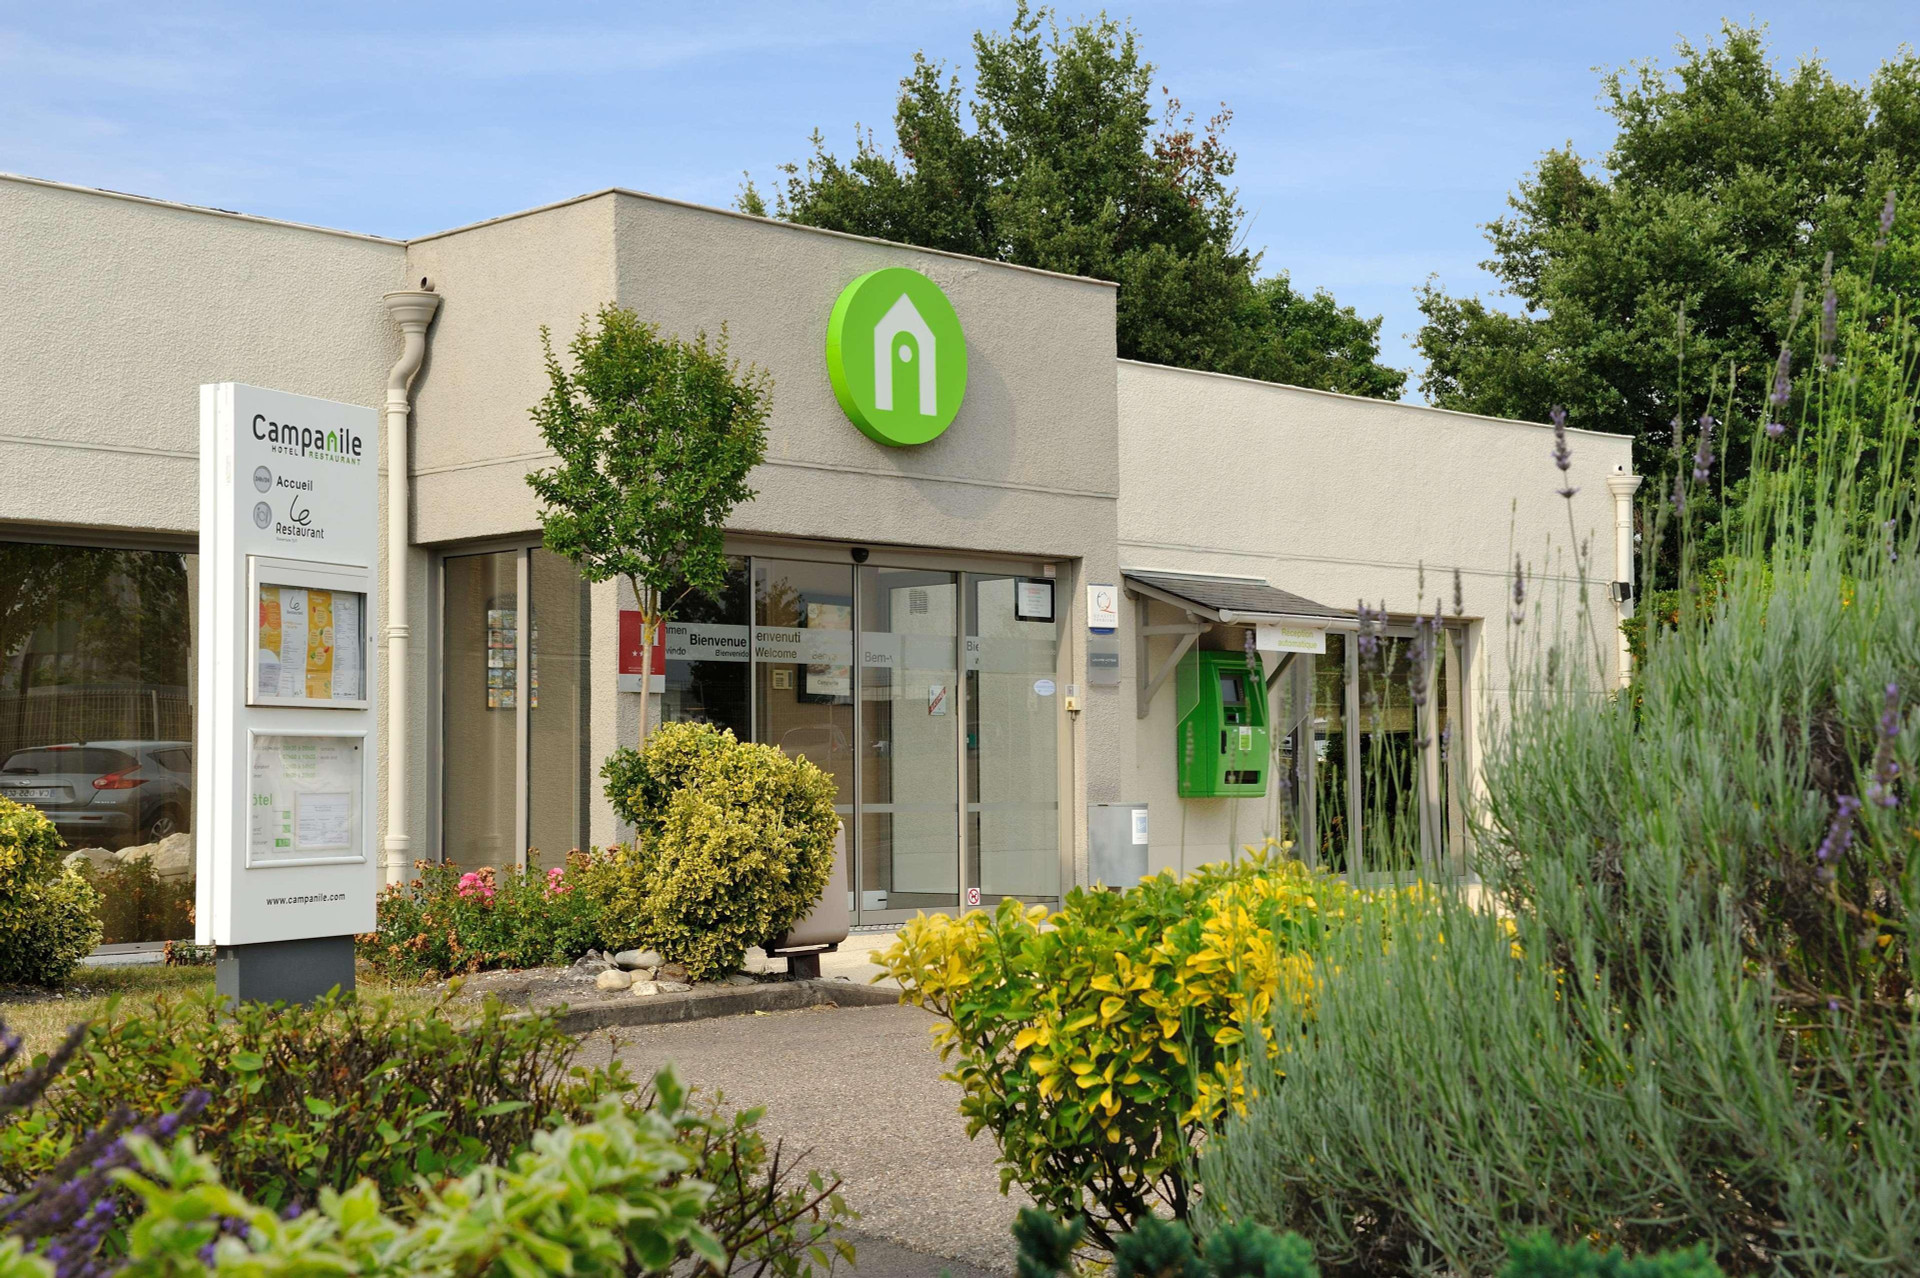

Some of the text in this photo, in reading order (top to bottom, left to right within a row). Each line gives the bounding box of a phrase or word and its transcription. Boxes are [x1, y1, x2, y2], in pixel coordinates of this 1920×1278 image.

[253, 414, 362, 457] Campanile
[272, 445, 361, 466] HOTEL RESTAURANT
[276, 475, 313, 491] Accueil
[276, 522, 325, 539] Restaurant
[690, 633, 747, 647] Bienvenue
[715, 649, 749, 657] Bienvenido
[755, 647, 797, 658] Welcome
[266, 893, 346, 905] www.campanile.com
